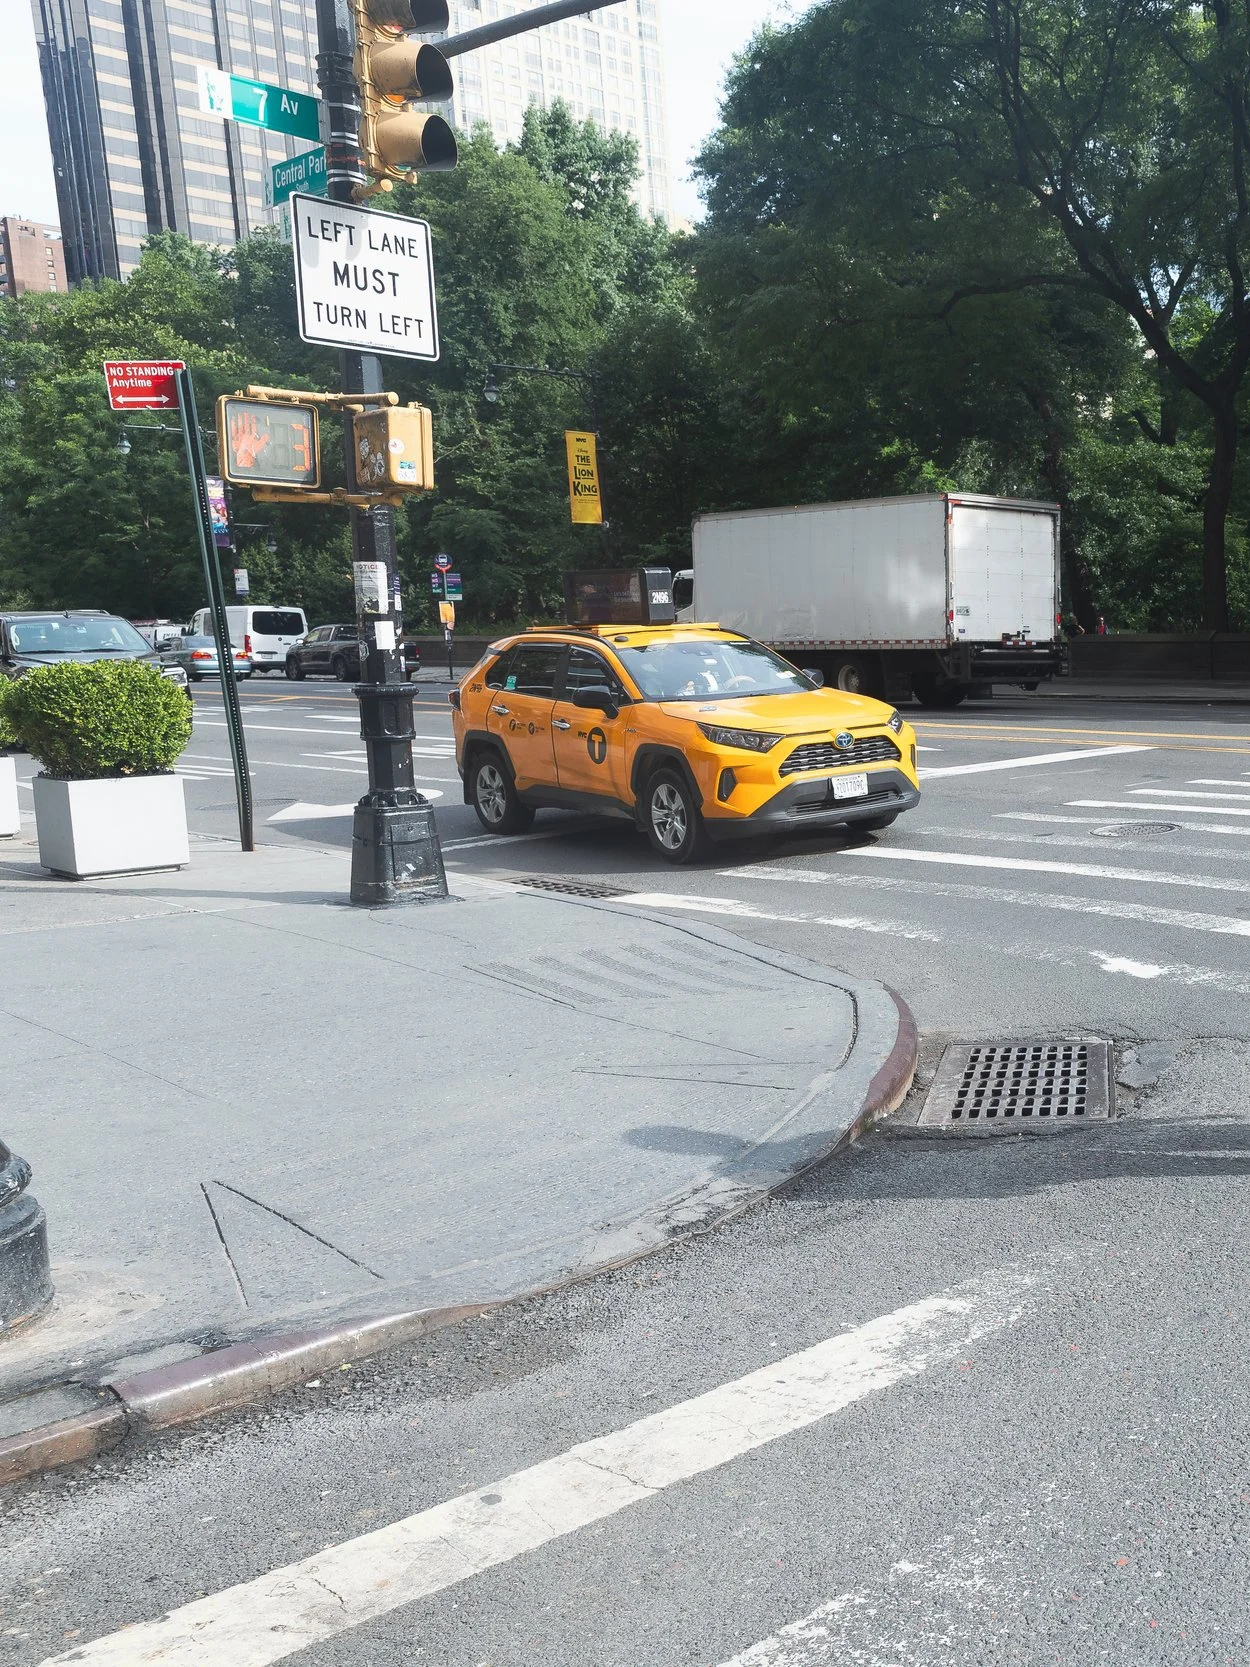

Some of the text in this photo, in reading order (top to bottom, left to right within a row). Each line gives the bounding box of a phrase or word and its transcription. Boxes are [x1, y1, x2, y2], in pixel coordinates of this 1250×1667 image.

[253, 87, 299, 122] 7 Av
[275, 158, 306, 189] Central
[307, 216, 418, 259] LEFT LANE
[332, 260, 400, 297] MUST
[313, 301, 424, 339] TURN LEFT
[109, 366, 174, 376] NO STANDING
[112, 378, 153, 389] Anytime
[291, 423, 311, 472] 3
[575, 454, 591, 464] THE
[572, 480, 598, 497] KING
[652, 591, 669, 603] 2N96
[578, 731, 587, 739] NYC
[591, 733, 603, 760] T
